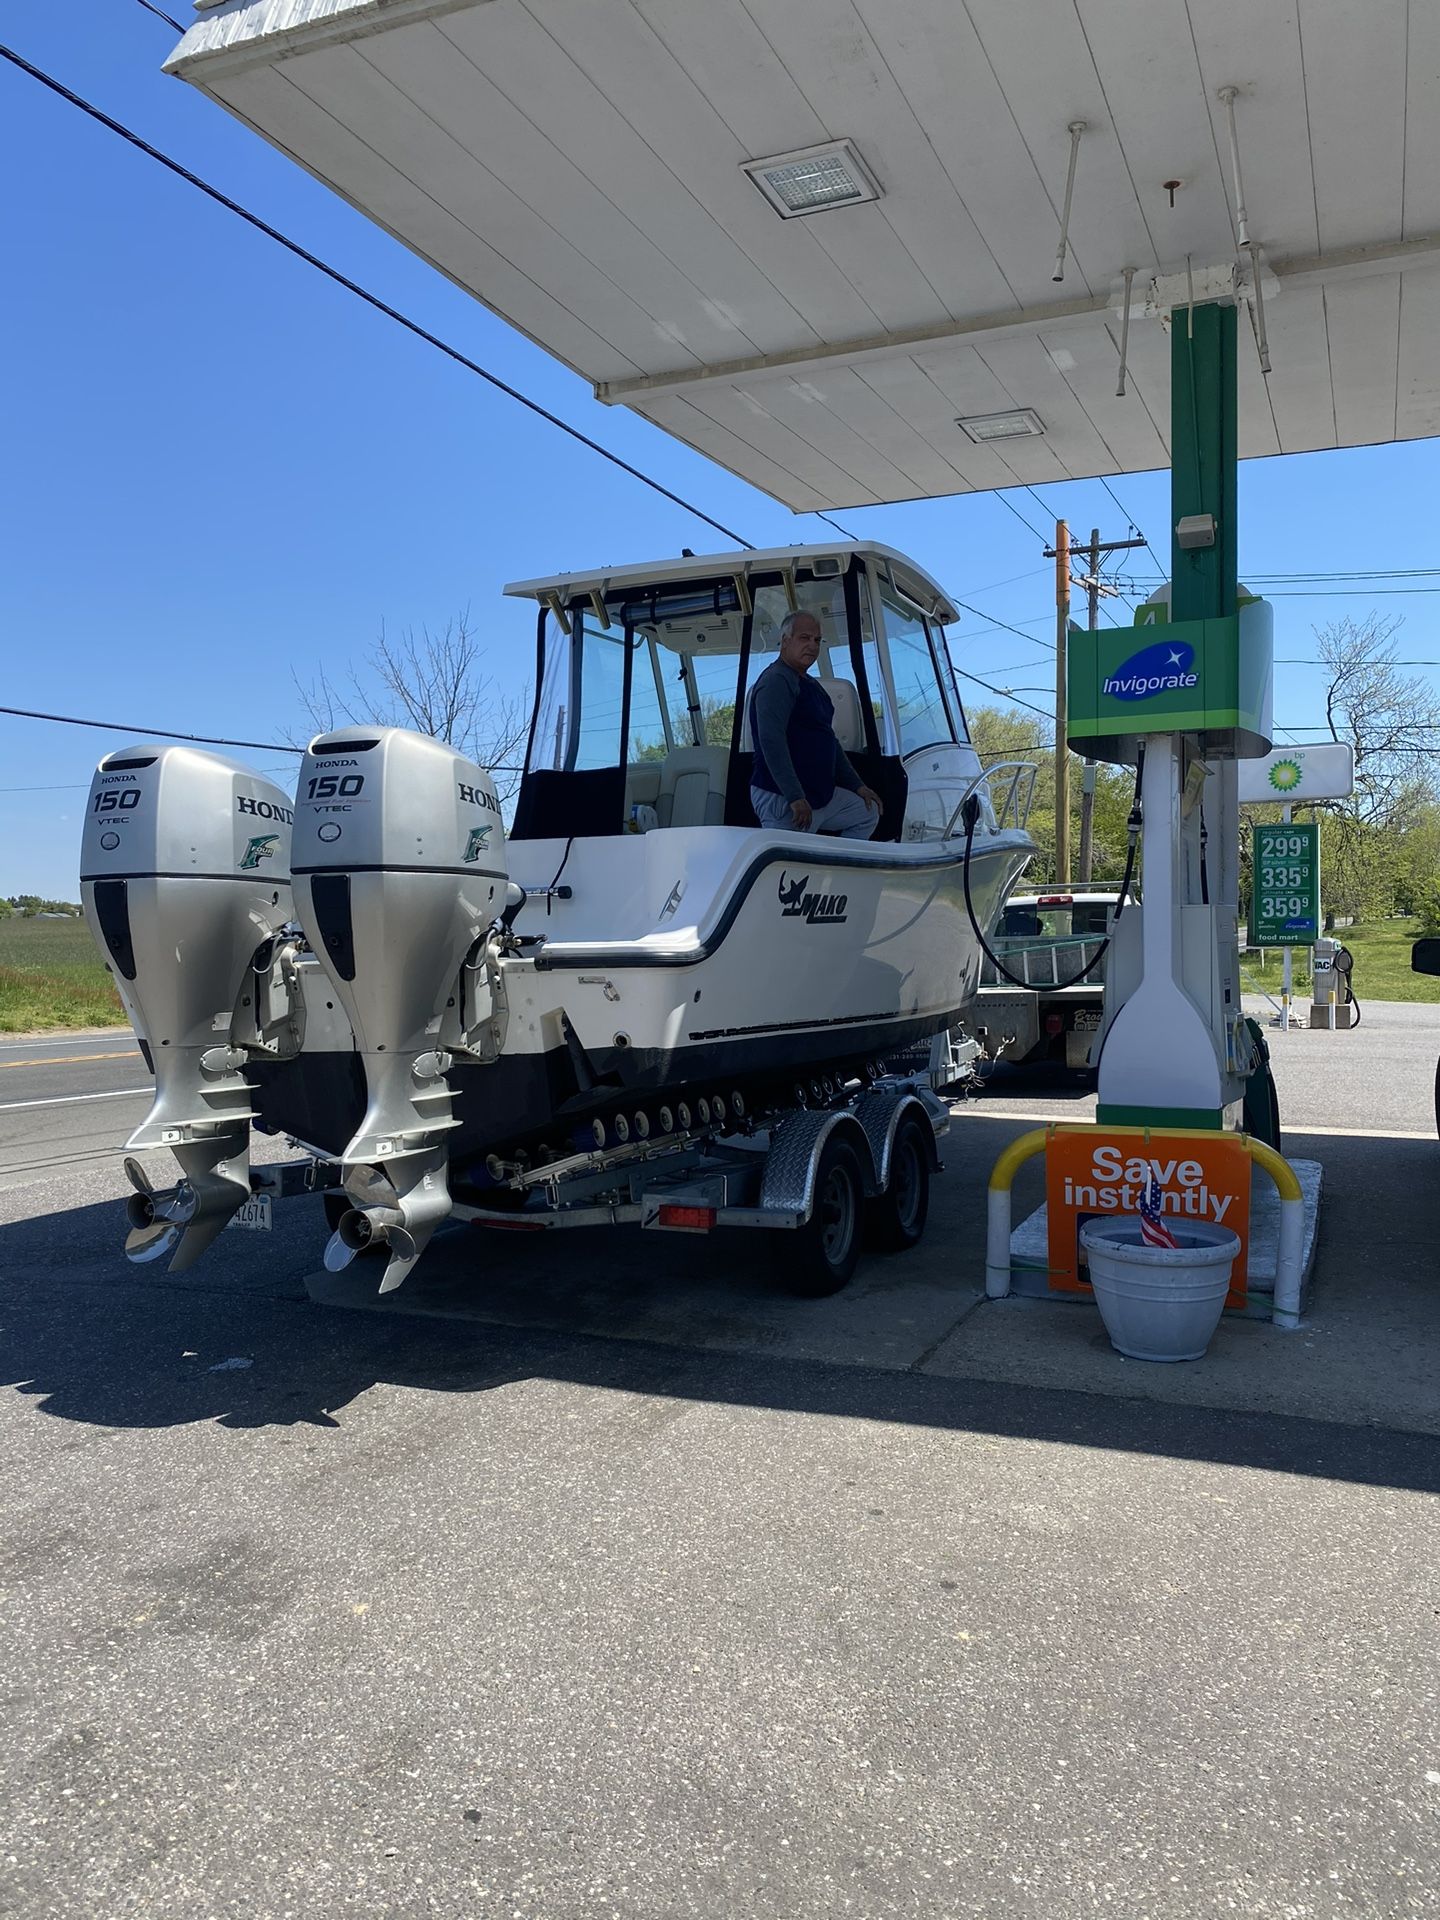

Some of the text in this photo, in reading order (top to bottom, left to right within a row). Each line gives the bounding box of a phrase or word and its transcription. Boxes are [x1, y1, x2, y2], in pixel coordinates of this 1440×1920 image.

[1103, 673, 1197, 695] Invigorate
[316, 759, 358, 769] HONDA
[1294, 752, 1305, 760] bp
[101, 775, 137, 784] HONDA
[308, 774, 364, 799] 150
[94, 789, 141, 812] 150
[313, 805, 352, 813] VTEC
[98, 817, 130, 825] VTEC
[801, 893, 848, 924] MAKO
[1092, 1146, 1204, 1187] Save
[1064, 1177, 1232, 1222] instntly
